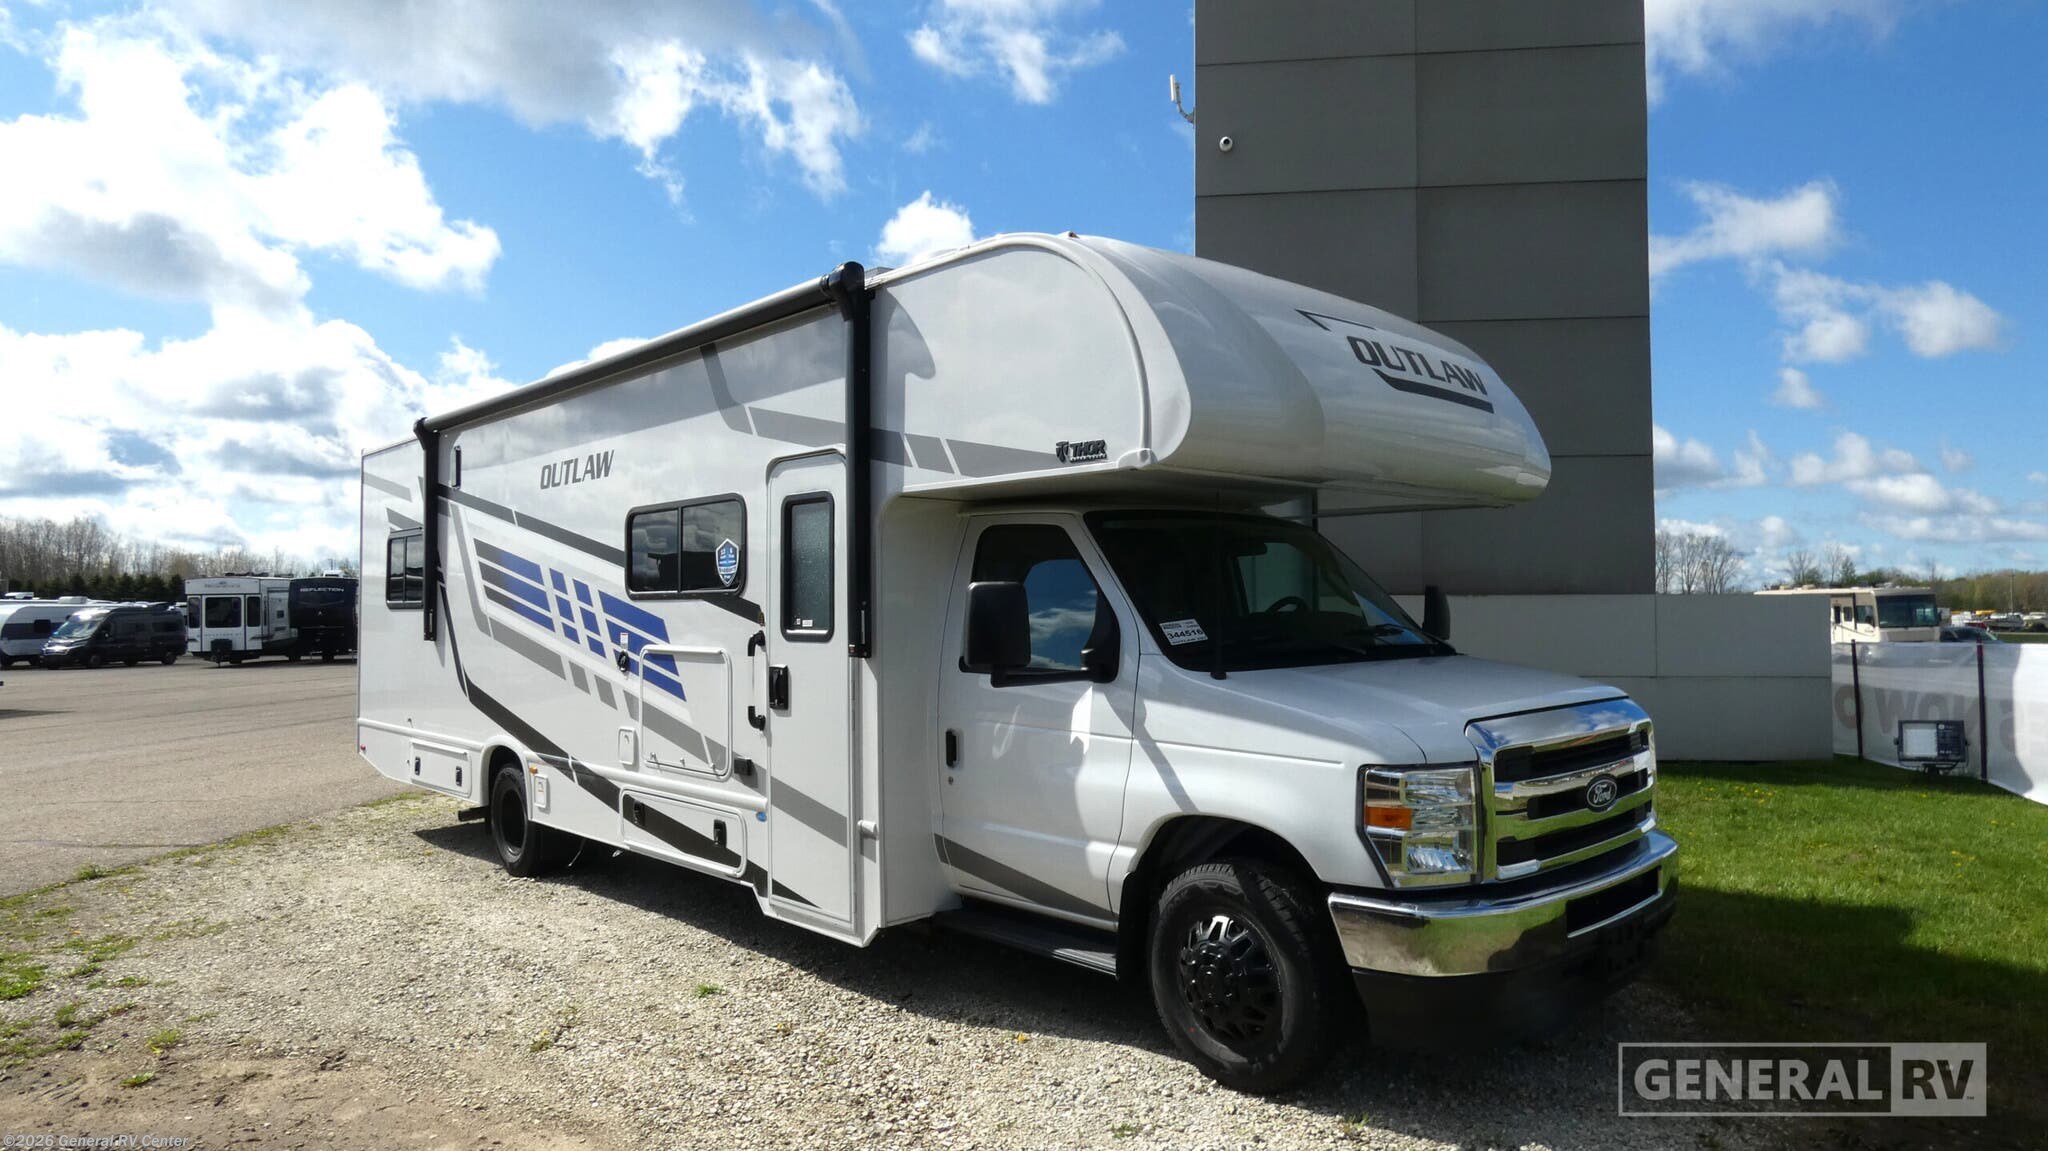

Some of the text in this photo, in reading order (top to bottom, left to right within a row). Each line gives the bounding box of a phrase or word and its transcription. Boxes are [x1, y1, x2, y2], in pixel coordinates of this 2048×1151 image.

[1346, 336, 1489, 396] OUTLAW
[1069, 440, 1106, 458] THOR
[540, 449, 615, 490] OUTLAW
[1593, 783, 1613, 804] Ford
